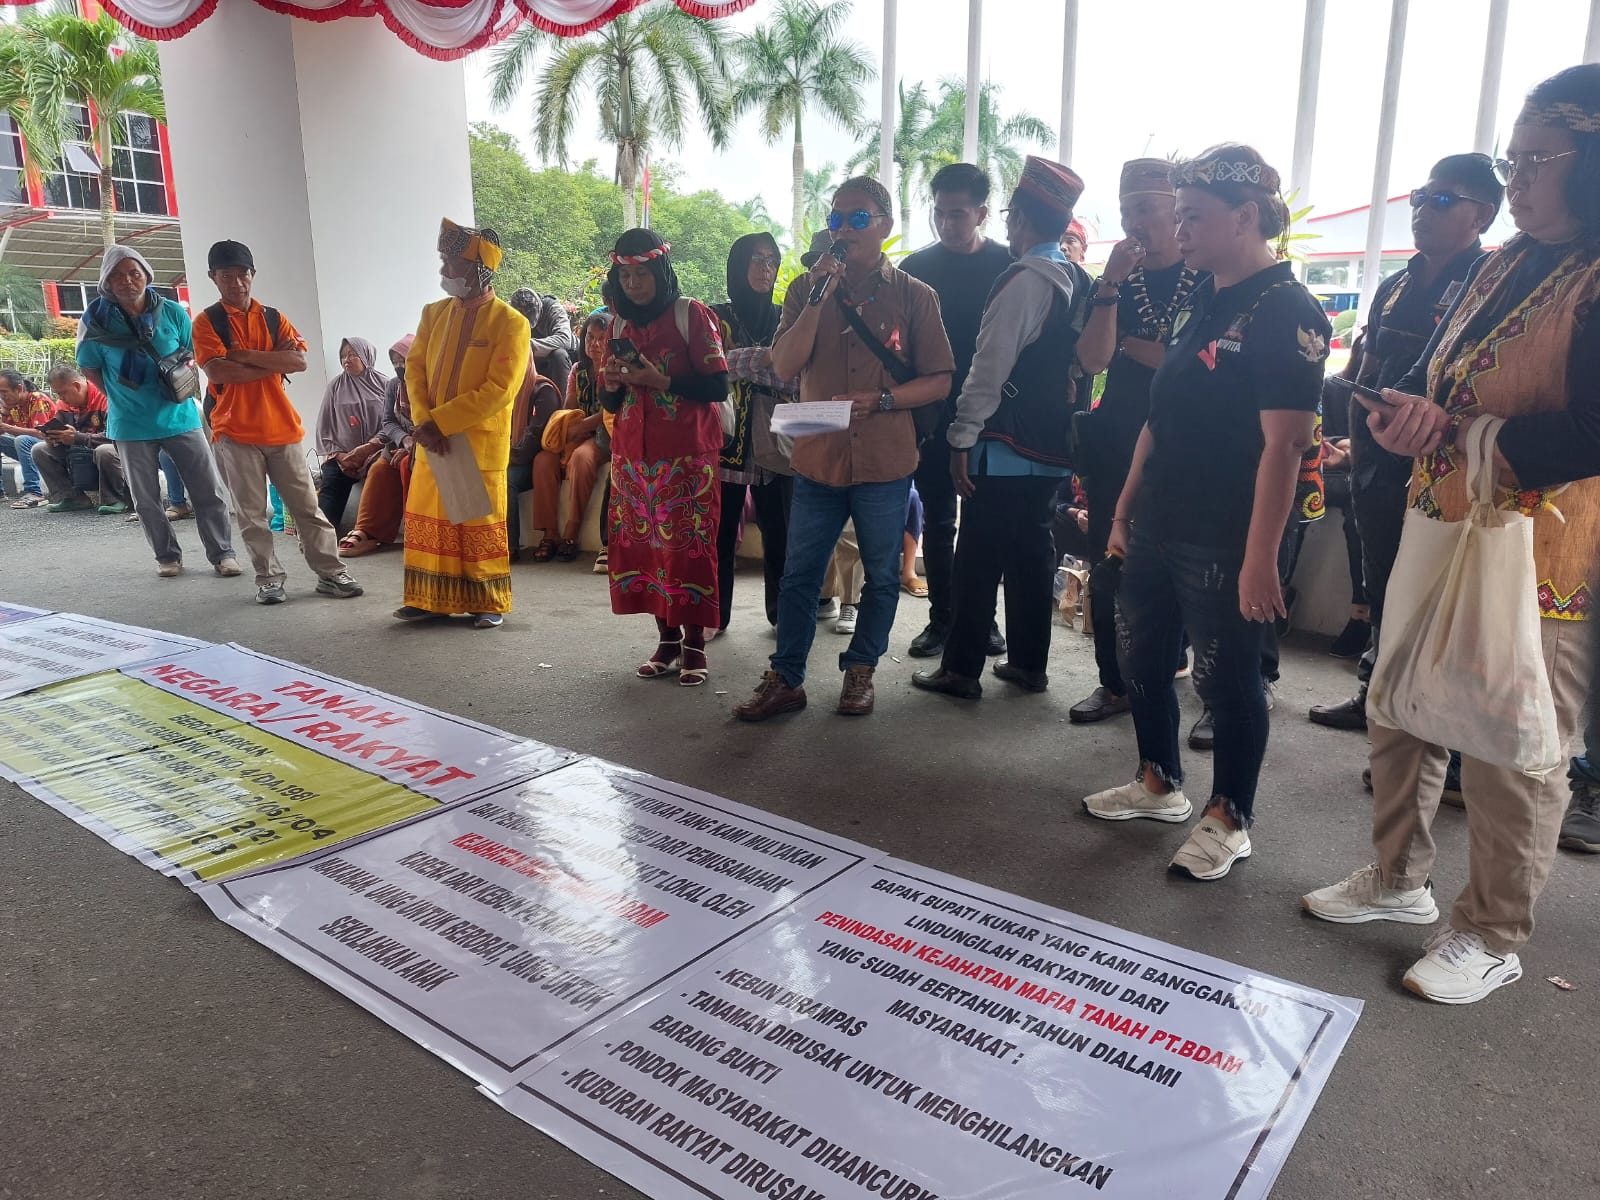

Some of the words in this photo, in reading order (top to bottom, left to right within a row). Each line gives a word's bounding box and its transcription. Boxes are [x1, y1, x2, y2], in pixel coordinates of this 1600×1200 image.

[272, 681, 409, 728] TANAH
[293, 721, 476, 785] RAKYAT
[448, 833, 531, 867] KEJAHATAN
[467, 803, 507, 819] DAN
[654, 875, 712, 903] LOKAL
[702, 894, 755, 919] OLEH
[633, 798, 684, 819] KUKAR
[674, 812, 718, 830] YANG
[706, 824, 754, 843] KAMI
[740, 835, 827, 869] MULYAKAN
[646, 835, 693, 855] DARI
[396, 851, 460, 881] KARENA
[440, 872, 489, 894] DARI
[468, 884, 531, 913] KEBUN
[309, 858, 384, 895] MAKANAN,
[364, 884, 417, 909] UANG
[396, 900, 461, 931] UNTUK
[438, 921, 519, 966] BEROBAT,
[500, 950, 561, 983] UANG
[319, 916, 421, 970] SEKOLAHKAN
[394, 959, 459, 992] ANAK
[871, 879, 926, 902] BAPAK
[920, 895, 981, 920] BUPATI
[977, 914, 1040, 941] KUKAR
[1041, 933, 1089, 957] YANG
[1088, 950, 1141, 975] KAMI
[1140, 967, 1267, 1018] BANGGAKAN
[720, 968, 784, 1000] KEBUN
[775, 991, 868, 1036] DIRAMPAS
[814, 911, 918, 954] PENINDASAN
[912, 945, 1019, 991] KEJAHATAN
[1015, 982, 1076, 1014] MAFIA
[1079, 1004, 1149, 1040] TANAH
[1148, 1030, 1243, 1072] PT.BDAM
[904, 915, 1019, 961] LINDUNGILAH
[1015, 954, 1120, 996] RAKYATMU
[1118, 988, 1170, 1015] DARI
[649, 1015, 726, 1056] BARANG
[716, 1047, 783, 1084] BUKTI
[817, 940, 864, 963] YANG
[860, 957, 924, 986] SUDAH
[918, 978, 1092, 1052] BERTAHUN-TAHUN
[1089, 1042, 1182, 1088] DIALAMI
[885, 1000, 1017, 1059] MASYARAKAT
[565, 1069, 661, 1125] KUBURAN
[647, 1112, 735, 1164] RAKYAT
[608, 1040, 691, 1087] PONDOK
[678, 1075, 812, 1148] MASYARAKAT
[688, 991, 773, 1035] TANAMAN
[763, 1024, 852, 1072] DIRUSAK
[845, 1060, 922, 1104] UNTUK
[913, 1092, 1113, 1190] MENGHILANGKAN
